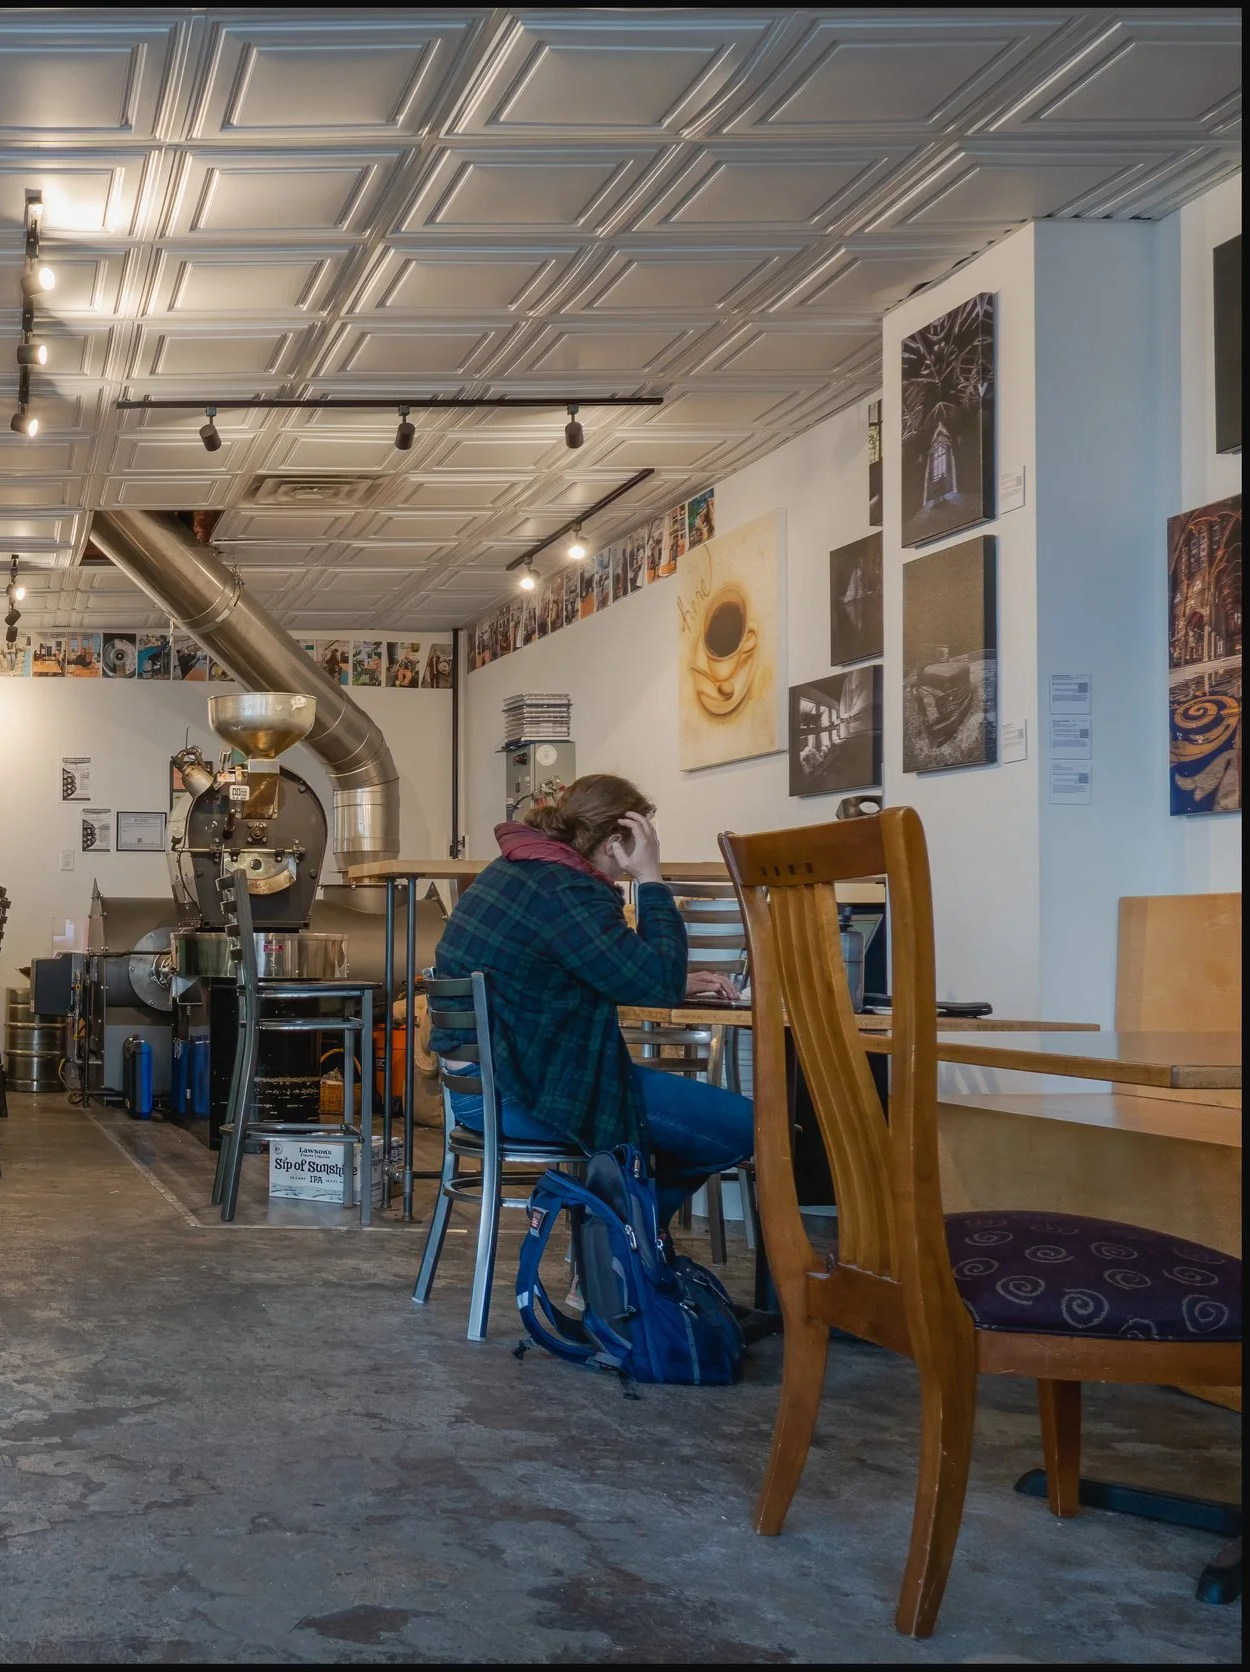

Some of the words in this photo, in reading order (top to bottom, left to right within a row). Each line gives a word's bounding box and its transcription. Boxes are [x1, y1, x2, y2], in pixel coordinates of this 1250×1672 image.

[274, 1156, 293, 1173] Sip
[293, 1158, 307, 1172] of
[307, 1160, 358, 1178] Sunshie
[309, 1175, 323, 1184] IPA
